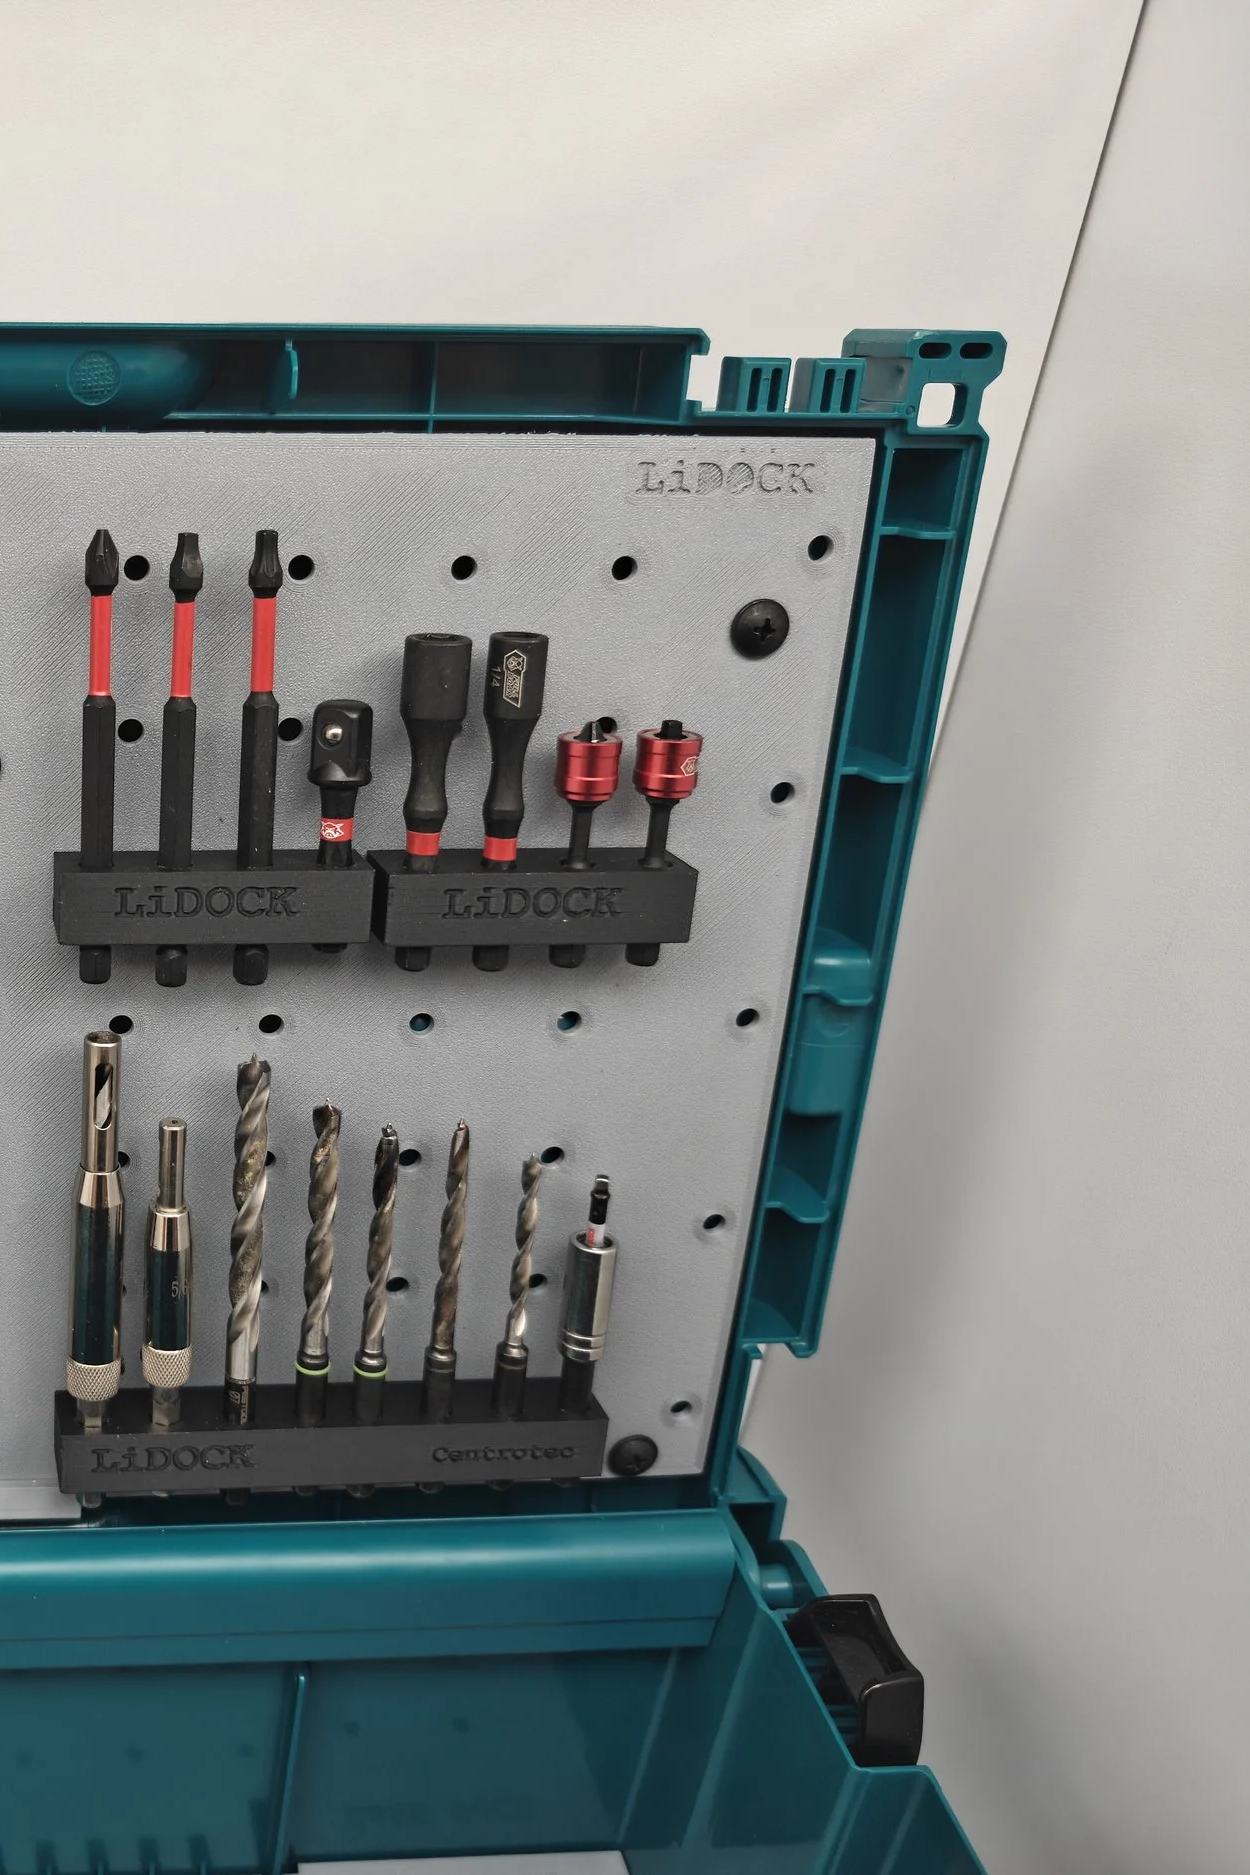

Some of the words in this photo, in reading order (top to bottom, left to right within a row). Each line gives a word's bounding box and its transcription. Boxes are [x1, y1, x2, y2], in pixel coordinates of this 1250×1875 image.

[635, 459, 816, 495] LiDOCK
[491, 666, 501, 687] 1/4
[113, 885, 301, 918] LiDOCK
[441, 885, 624, 920] LiDOCK
[90, 1444, 257, 1474] LiDOCK
[431, 1444, 576, 1463] Centrotec
